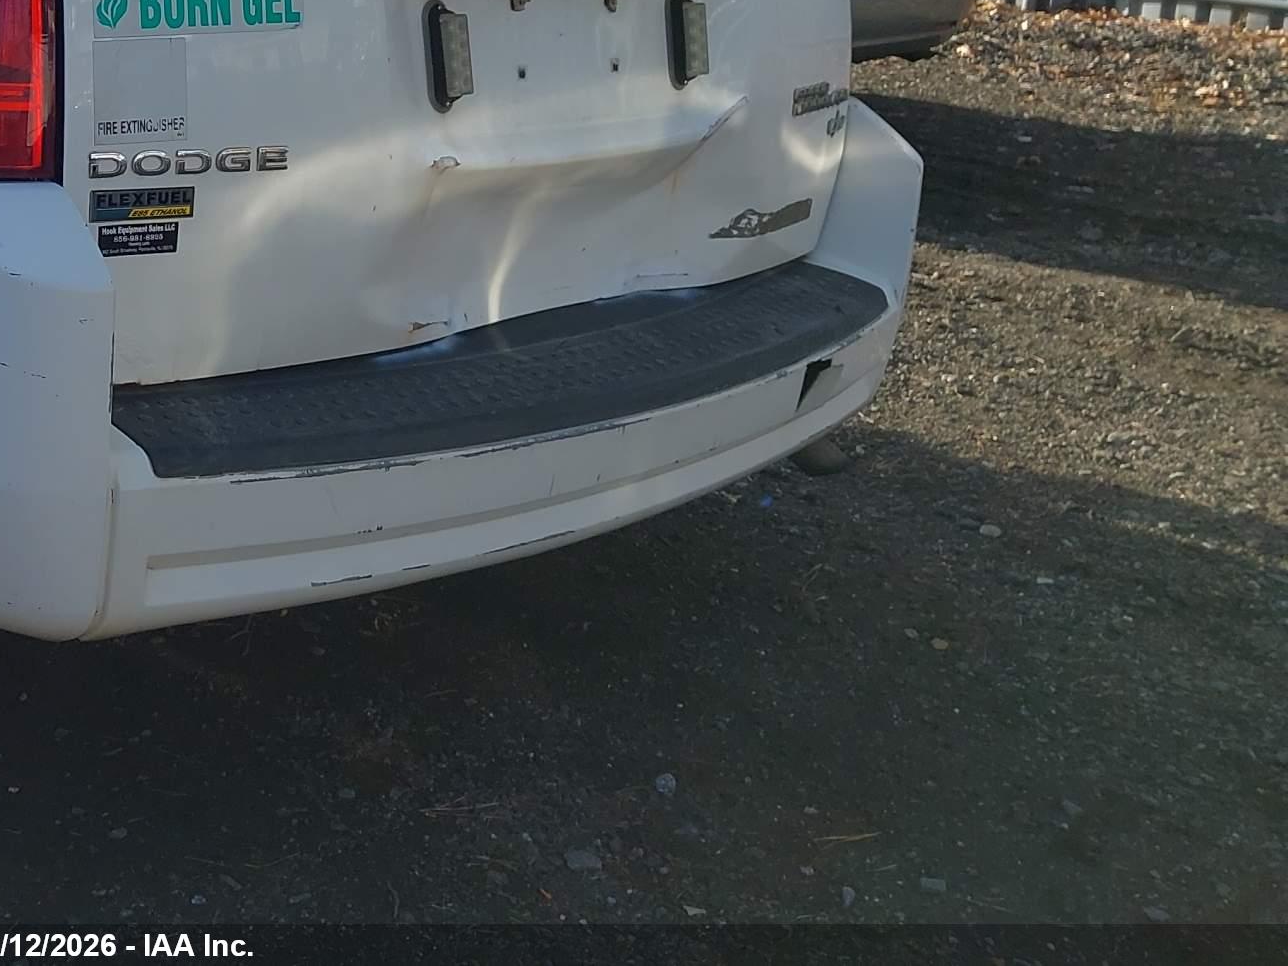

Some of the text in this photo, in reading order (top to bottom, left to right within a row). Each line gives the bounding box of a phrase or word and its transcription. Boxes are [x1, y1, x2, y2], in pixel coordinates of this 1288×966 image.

[98, 121, 118, 136] FIRE
[88, 145, 289, 179] DODGE
[96, 190, 191, 208] FLEXFUEL
[150, 207, 188, 216] ETHANOL
[148, 224, 164, 233] Sales
[164, 223, 176, 232] LLC
